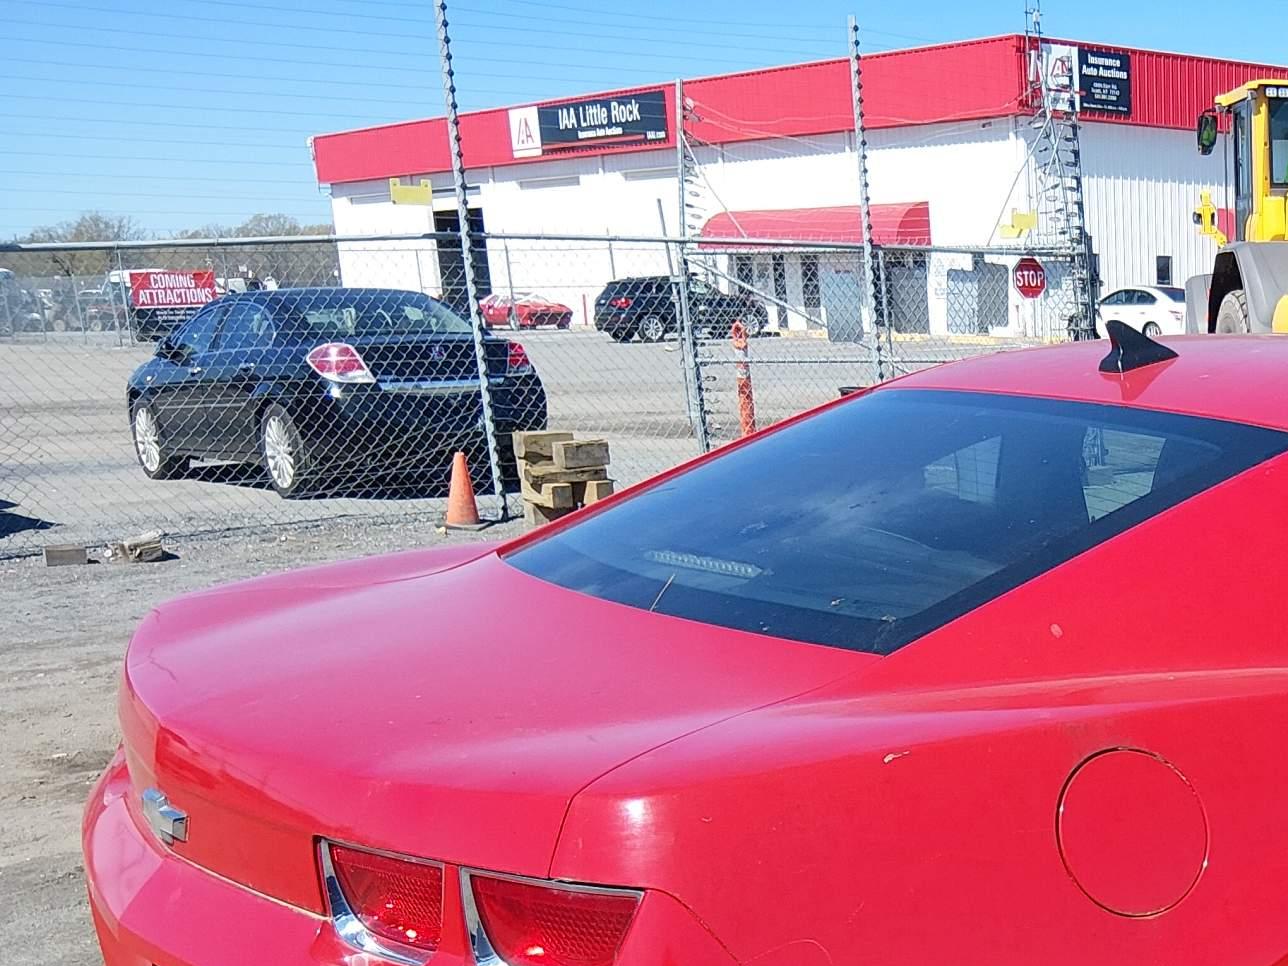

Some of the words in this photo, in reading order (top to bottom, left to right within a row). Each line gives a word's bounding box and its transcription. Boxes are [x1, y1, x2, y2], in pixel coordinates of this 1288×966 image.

[1088, 53, 1121, 67] Insurance
[1082, 64, 1098, 76] Auto
[1099, 66, 1128, 80] Auctions
[558, 106, 578, 130] IAA
[579, 103, 608, 128] Little
[611, 99, 641, 124] Rock
[149, 273, 196, 289] COMING
[1016, 270, 1044, 287] STOP
[139, 287, 213, 305] ATTRACTIONS
